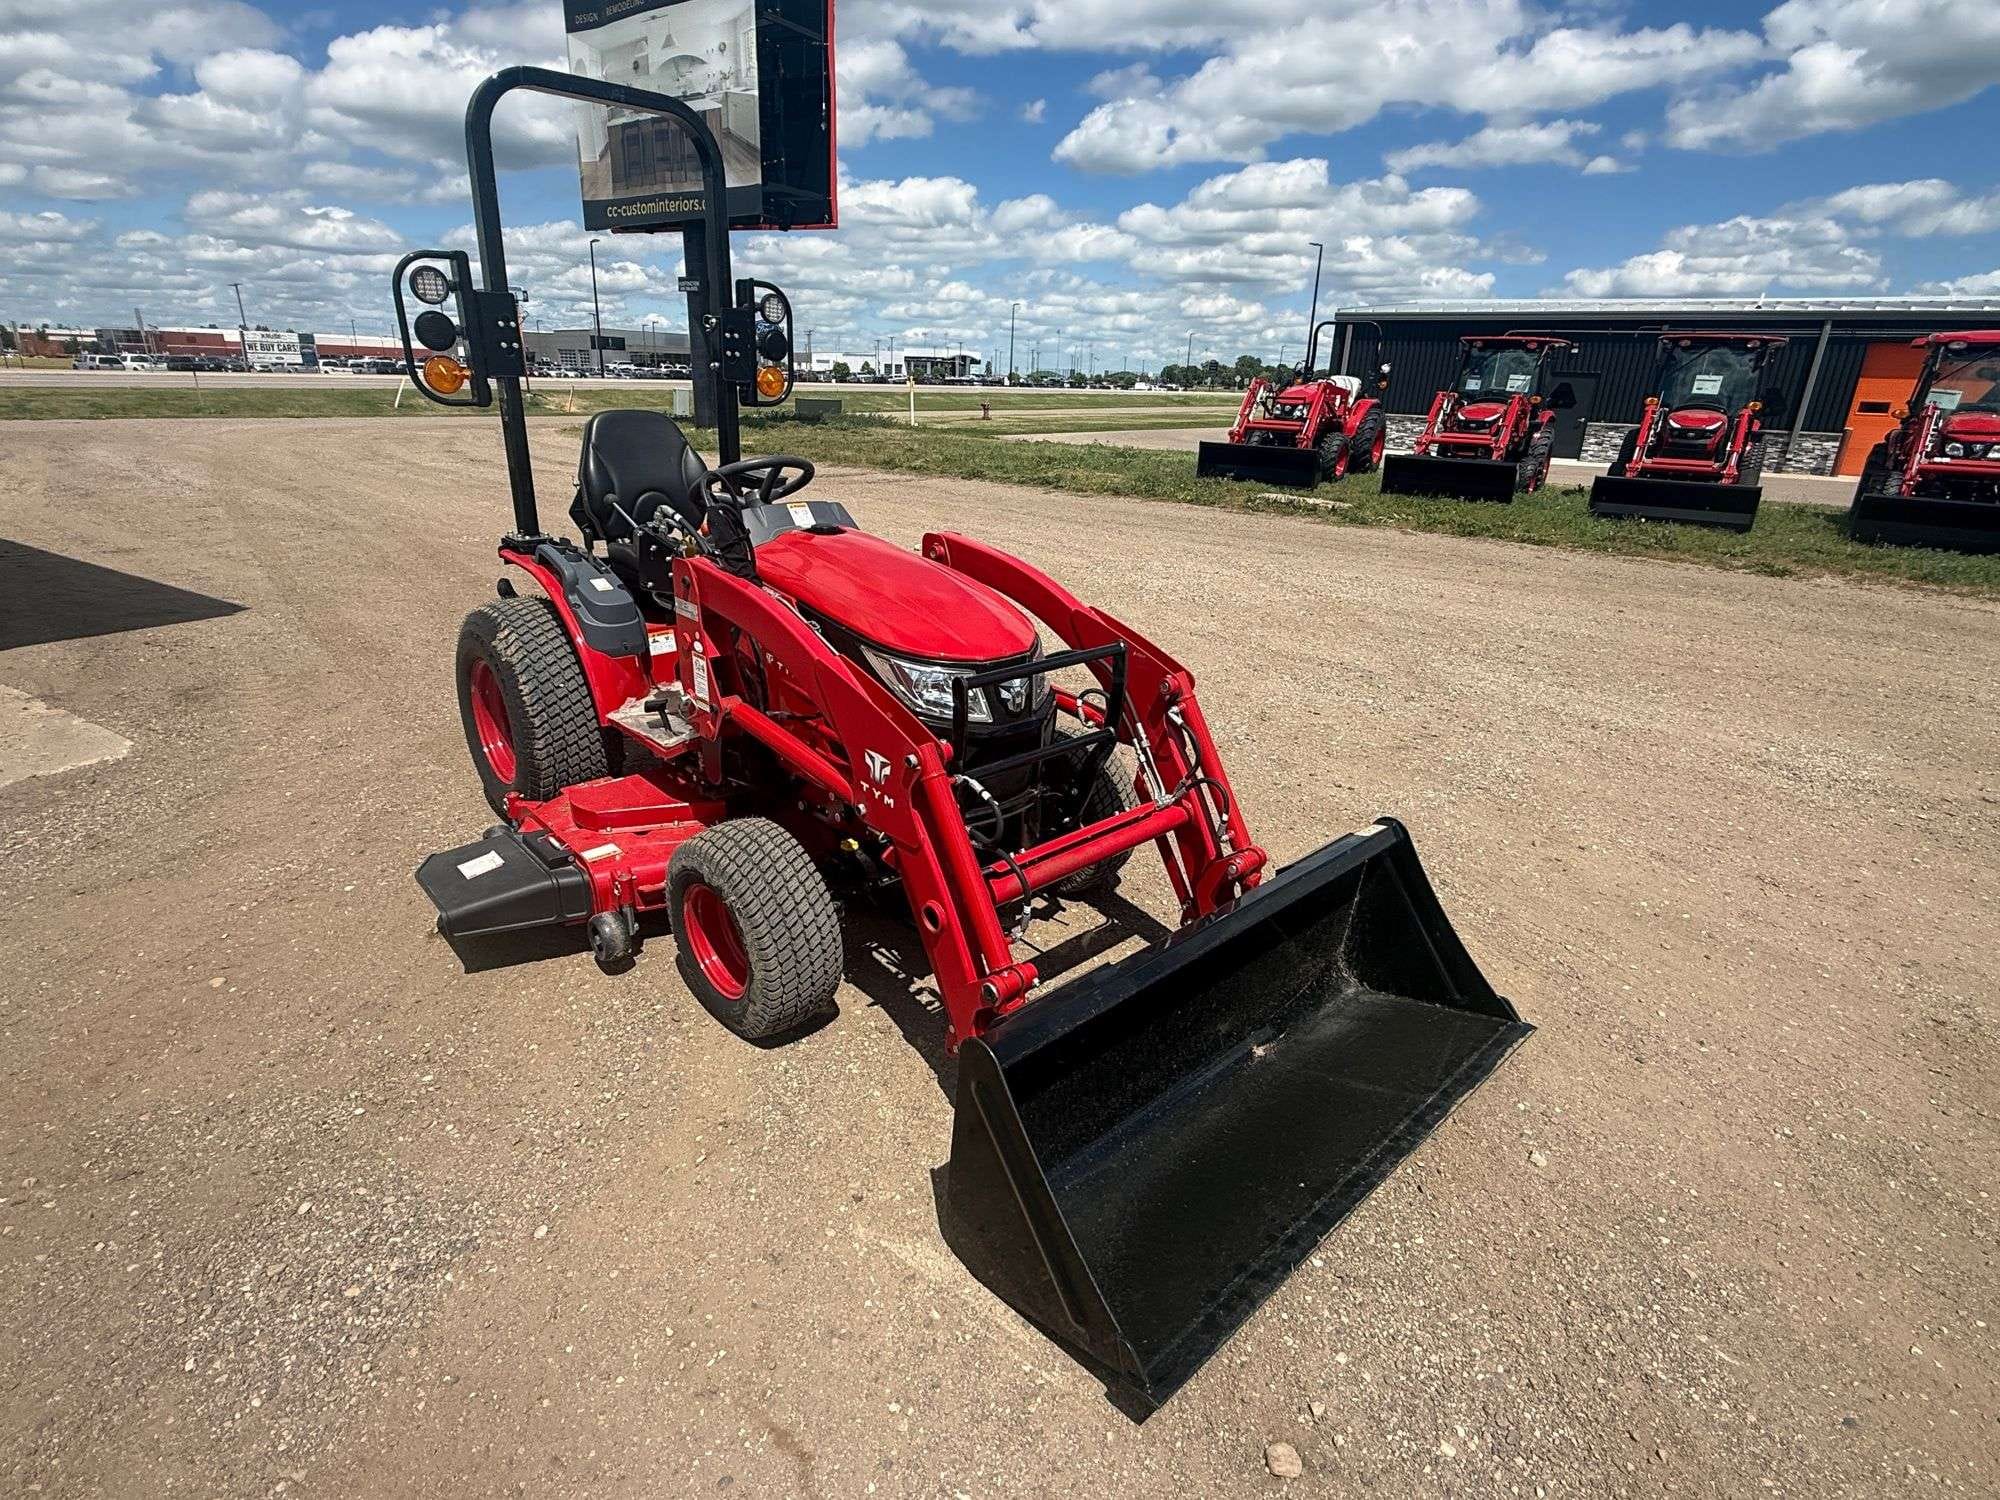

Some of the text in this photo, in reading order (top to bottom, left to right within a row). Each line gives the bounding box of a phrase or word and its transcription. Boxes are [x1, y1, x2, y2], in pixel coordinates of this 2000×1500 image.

[575, 13, 599, 24] DESIGN
[247, 343, 259, 352] WE
[260, 342, 275, 352] BUY
[860, 780, 894, 808] TYM
